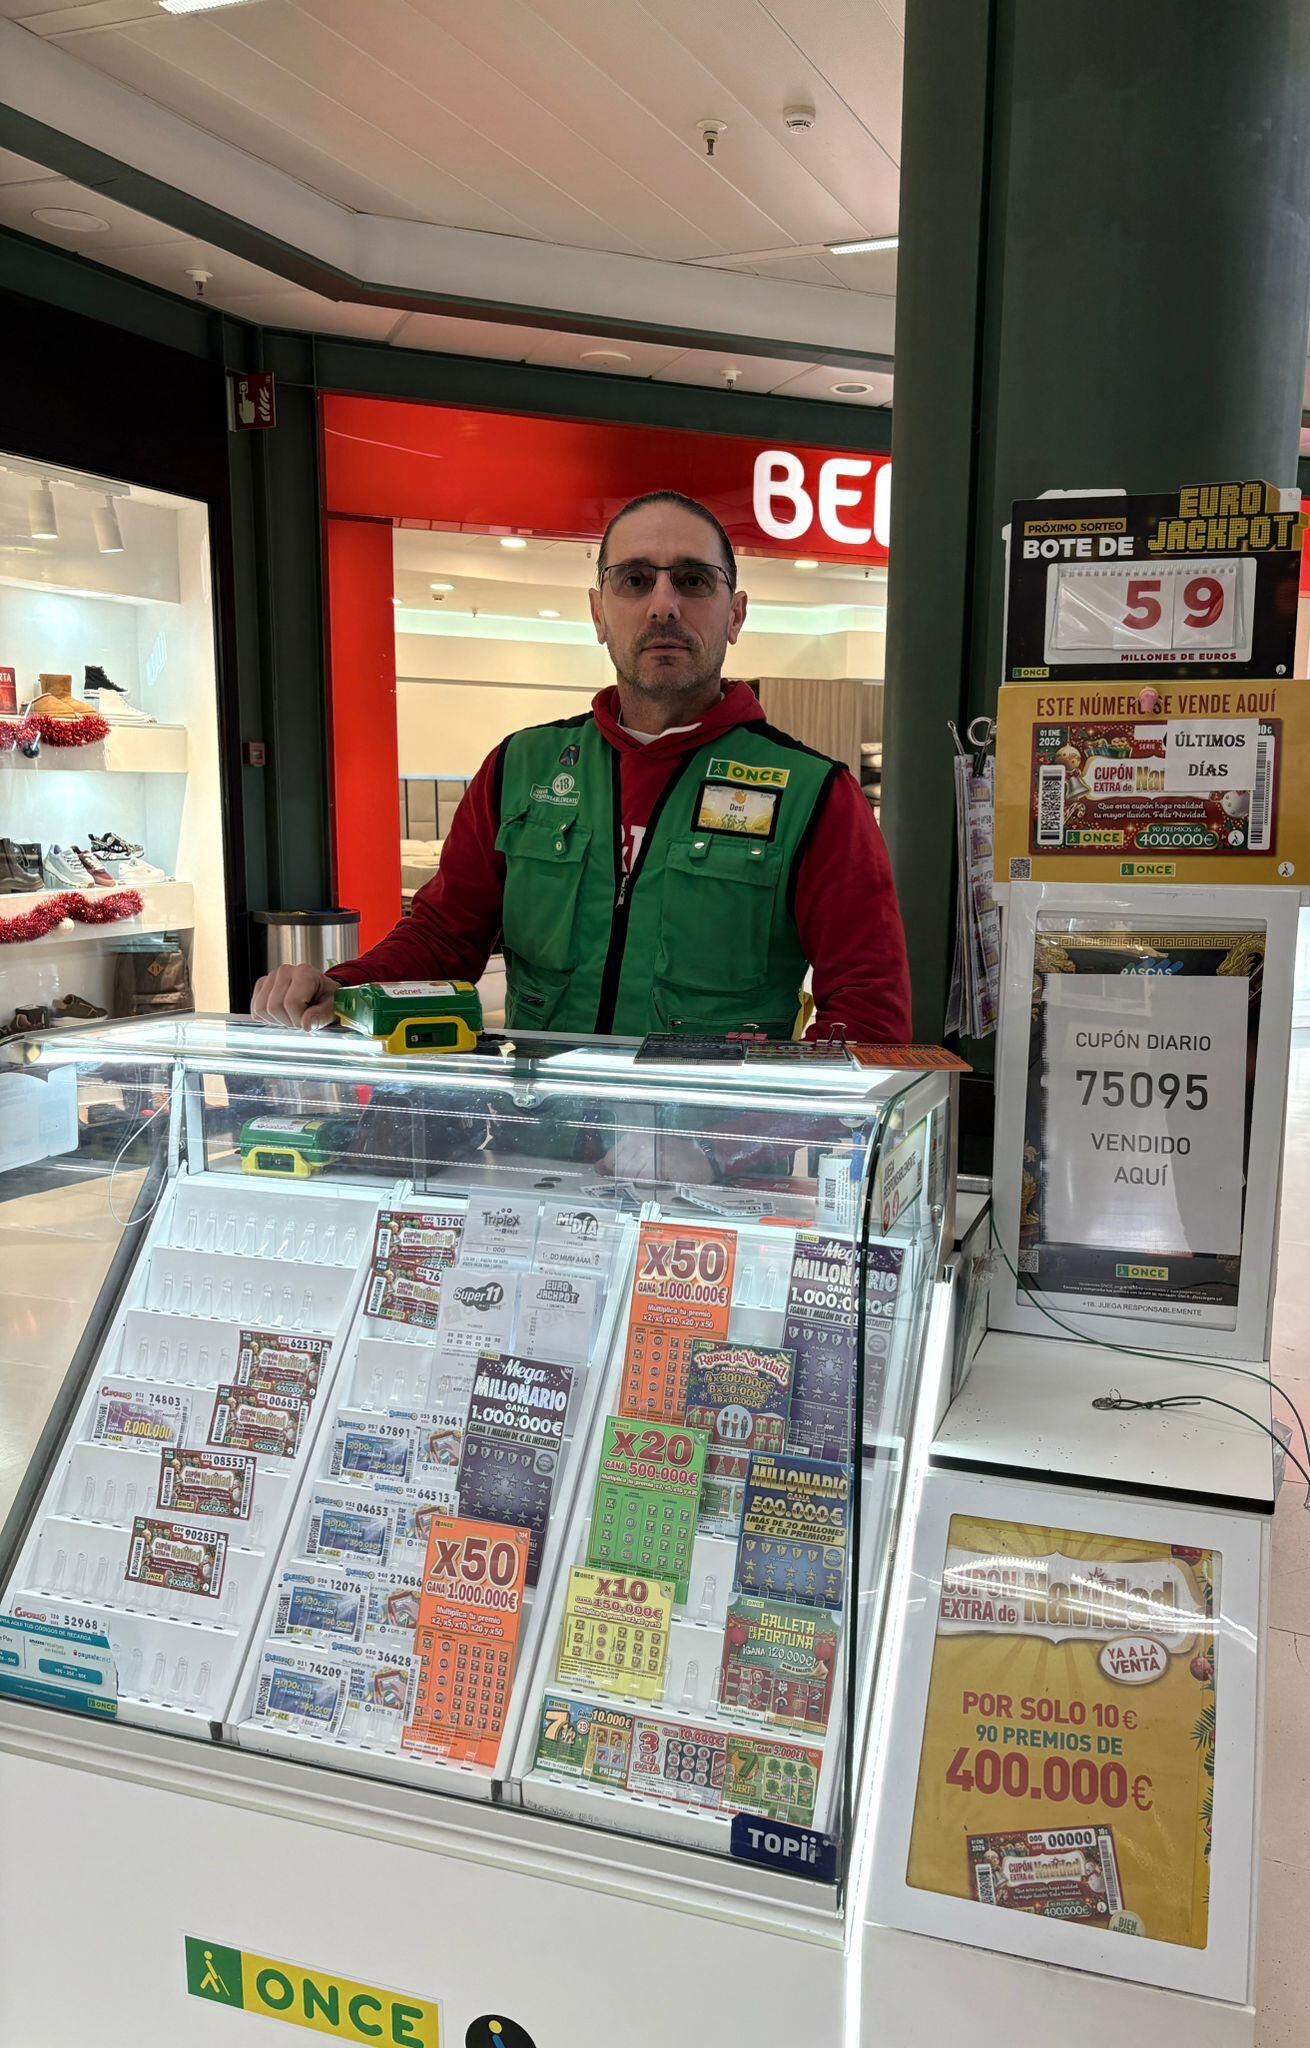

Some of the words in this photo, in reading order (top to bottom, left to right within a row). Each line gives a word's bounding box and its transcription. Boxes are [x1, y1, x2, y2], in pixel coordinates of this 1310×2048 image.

[1179, 484, 1262, 517] EURO
[1028, 522, 1076, 534] PRÓXIMO
[1080, 521, 1123, 532] SORTEO
[1148, 515, 1293, 550] JACKPOT
[1022, 538, 1093, 559] BOTE
[1098, 537, 1134, 557] DE
[1121, 652, 1176, 662] MILLONES
[1180, 652, 1195, 661] DE
[1199, 652, 1237, 661] EUROS
[1023, 669, 1047, 677] ONCE
[1037, 698, 1074, 717] ESTE
[1178, 694, 1231, 714] VENDE
[1238, 688, 1276, 713] AQUÍ
[1039, 738, 1061, 746] 2026
[1175, 732, 1246, 748] ÚLTIMOS
[732, 767, 783, 783] ONCE
[1095, 764, 1134, 780] CUPÓN
[1188, 761, 1229, 777] DÍAS
[1094, 782, 1121, 792] EXTRA
[1122, 783, 1132, 792] de
[1098, 802, 1114, 810] Que
[1132, 802, 1154, 811] cupón
[1154, 802, 1173, 811] haga
[1083, 834, 1120, 842] ONCE
[1140, 834, 1214, 846] 400.000€
[1136, 864, 1172, 875] ONCE
[393, 988, 422, 996] Getnet
[1076, 1028, 1140, 1049] CUPÓN
[1147, 1033, 1211, 1051] DIARIO
[1076, 1070, 1209, 1111] 75095
[1092, 1133, 1191, 1156] VENDIDO
[1114, 1164, 1169, 1187] AQUÍ
[1132, 1268, 1165, 1278] ONCE
[546, 1280, 570, 1292] EURO
[638, 1282, 657, 1294] GANA
[658, 1282, 727, 1304] 1.000.000€
[827, 1284, 853, 1295] GANA
[537, 1289, 579, 1304] JACKPOT
[648, 1304, 678, 1315] Multiplica
[688, 1310, 712, 1319] premio
[1098, 1302, 1123, 1310] JUEGA
[1123, 1304, 1202, 1316] RESPONSABLEMENTE
[834, 1314, 843, 1323] DE
[290, 1339, 320, 1352] 62512
[502, 1359, 546, 1384] Mega
[696, 1352, 733, 1366] Rasca
[734, 1354, 744, 1362] de
[743, 1350, 788, 1384] Navidad
[149, 1393, 181, 1407] 74803
[474, 1376, 567, 1412] MILLONARIO
[268, 1398, 299, 1410] 00683
[505, 1402, 529, 1415] GANA
[432, 1414, 463, 1428] 87641
[472, 1405, 564, 1437] 1.000.000€
[380, 1425, 411, 1439] 67891
[490, 1425, 511, 1439] MILLÓN
[510, 1431, 519, 1440] DE
[524, 1434, 531, 1442] AL
[531, 1435, 559, 1449] INSTANTE!
[214, 1456, 245, 1468] 08553
[604, 1460, 626, 1471] GANA
[629, 1462, 699, 1487] 500.000€
[750, 1464, 848, 1500] MILLONARIO
[418, 1489, 450, 1503] 64513
[356, 1502, 389, 1517] 04653
[751, 1496, 844, 1526] 500.000€
[185, 1530, 216, 1544] 90285
[754, 1524, 767, 1532] DE
[790, 1530, 835, 1543] PREMIOS!
[800, 1524, 845, 1537] MILLONES
[330, 1580, 361, 1594] 12076
[390, 1574, 422, 1587] 27486
[426, 1581, 445, 1593] GANA
[448, 1582, 518, 1610] 1.000.000€
[436, 1606, 467, 1618] Multiplica
[469, 1612, 477, 1620] tu
[478, 1615, 501, 1625] premio
[592, 1599, 663, 1620] 150.000€
[940, 1598, 994, 1621] EXTRA
[998, 1604, 1016, 1623] de
[64, 1616, 98, 1630] 52968
[471, 1624, 483, 1632] x20
[490, 1626, 503, 1636] x50
[760, 1613, 816, 1635] GALLETA
[34, 1624, 58, 1635] CÓDIGOS
[67, 1631, 91, 1641] RECARGA
[756, 1627, 814, 1650] FORTUNA
[78, 1652, 111, 1664] paysafecard
[378, 1651, 411, 1667] 36428
[1108, 1648, 1126, 1661] YA
[1128, 1647, 1138, 1658] A
[1143, 1644, 1159, 1657] LA
[310, 1662, 342, 1678] 74209
[1110, 1658, 1161, 1675] VENTA
[96, 1700, 116, 1711] ONCE
[962, 1691, 1013, 1720] POR
[1021, 1699, 1086, 1725] SOLO
[1092, 1703, 1138, 1731] 10€
[592, 1708, 632, 1729] 10.000€
[639, 1731, 660, 1754] 3
[976, 1724, 1000, 1744] 90
[1003, 1726, 1092, 1753] PREMIOS
[1096, 1737, 1124, 1756] DE
[738, 1752, 758, 1779] 7
[945, 1747, 1154, 1812] 400.000€
[729, 1783, 756, 1797] SUERTE
[1029, 1835, 1043, 1843] 000
[1048, 1831, 1093, 1847] 00000
[1008, 1861, 1034, 1873] CUPÓN
[1034, 1857, 1082, 1880] Navidad
[1010, 1873, 1027, 1881] EXTRA
[1118, 1916, 1138, 1930] BIEN
[256, 1968, 425, 2048] ONCE
